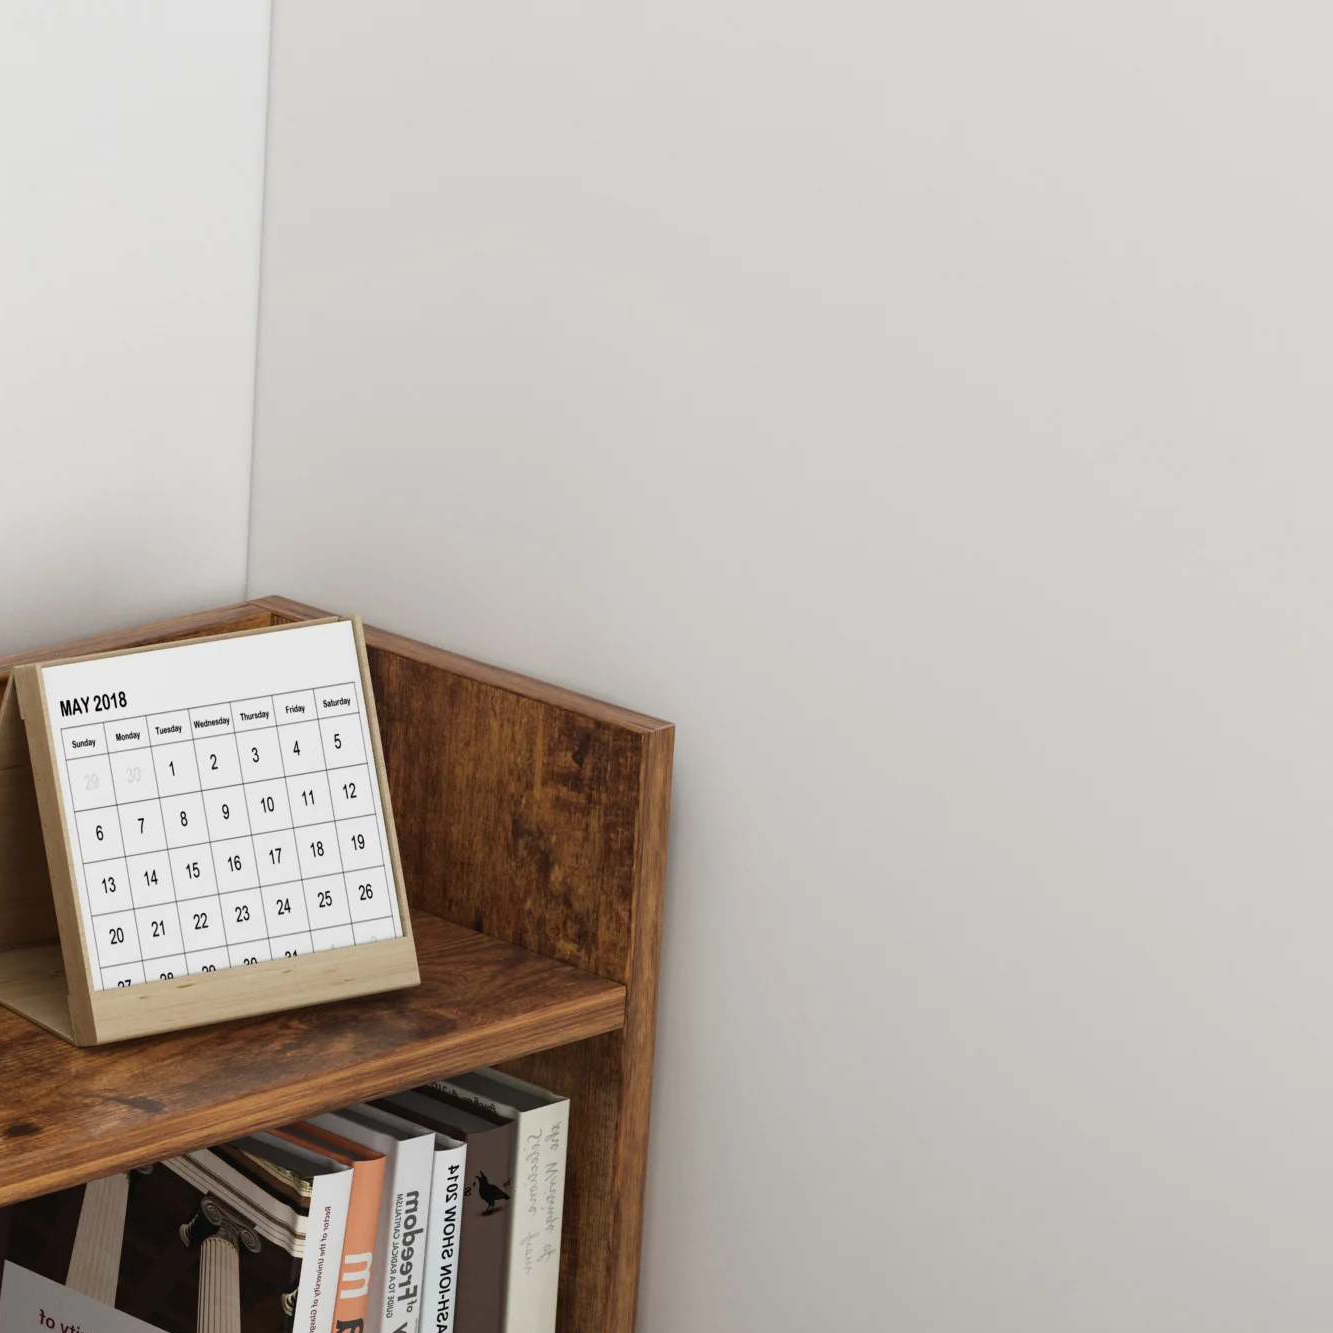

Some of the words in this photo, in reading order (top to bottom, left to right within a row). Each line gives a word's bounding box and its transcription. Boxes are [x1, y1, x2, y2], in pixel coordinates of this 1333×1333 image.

[60, 696, 89, 717] MAY
[93, 691, 127, 712] 2018
[71, 738, 96, 749] Sunday
[115, 731, 141, 741] Monday
[155, 724, 182, 735] Tuesday
[193, 717, 230, 729] Wednesday
[239, 710, 270, 721] Thursday
[285, 704, 305, 714] Friday
[322, 697, 351, 708] Saturday
[84, 774, 99, 790] 29
[126, 767, 141, 783] 30
[169, 761, 175, 776] 1
[209, 754, 219, 770] 2
[251, 748, 260, 762] 3
[293, 741, 301, 755] 4
[334, 734, 342, 749] 5
[95, 826, 104, 840] 6
[137, 818, 145, 833] 7
[179, 811, 188, 826] 8
[221, 804, 230, 819] 9
[260, 797, 275, 812] 10
[301, 790, 315, 805] 11
[342, 783, 357, 799] 12
[101, 877, 117, 893] 13
[143, 870, 159, 886] 14
[185, 862, 201, 878] 15
[227, 856, 242, 871] 16
[269, 848, 282, 864] 17
[310, 841, 325, 857] 18
[351, 834, 365, 850] 19
[108, 928, 125, 944] 20
[151, 921, 166, 937] 21
[193, 913, 209, 929] 22
[234, 906, 250, 922] 23
[276, 899, 292, 915] 24
[317, 891, 333, 907] 25
[358, 884, 374, 900] 26
